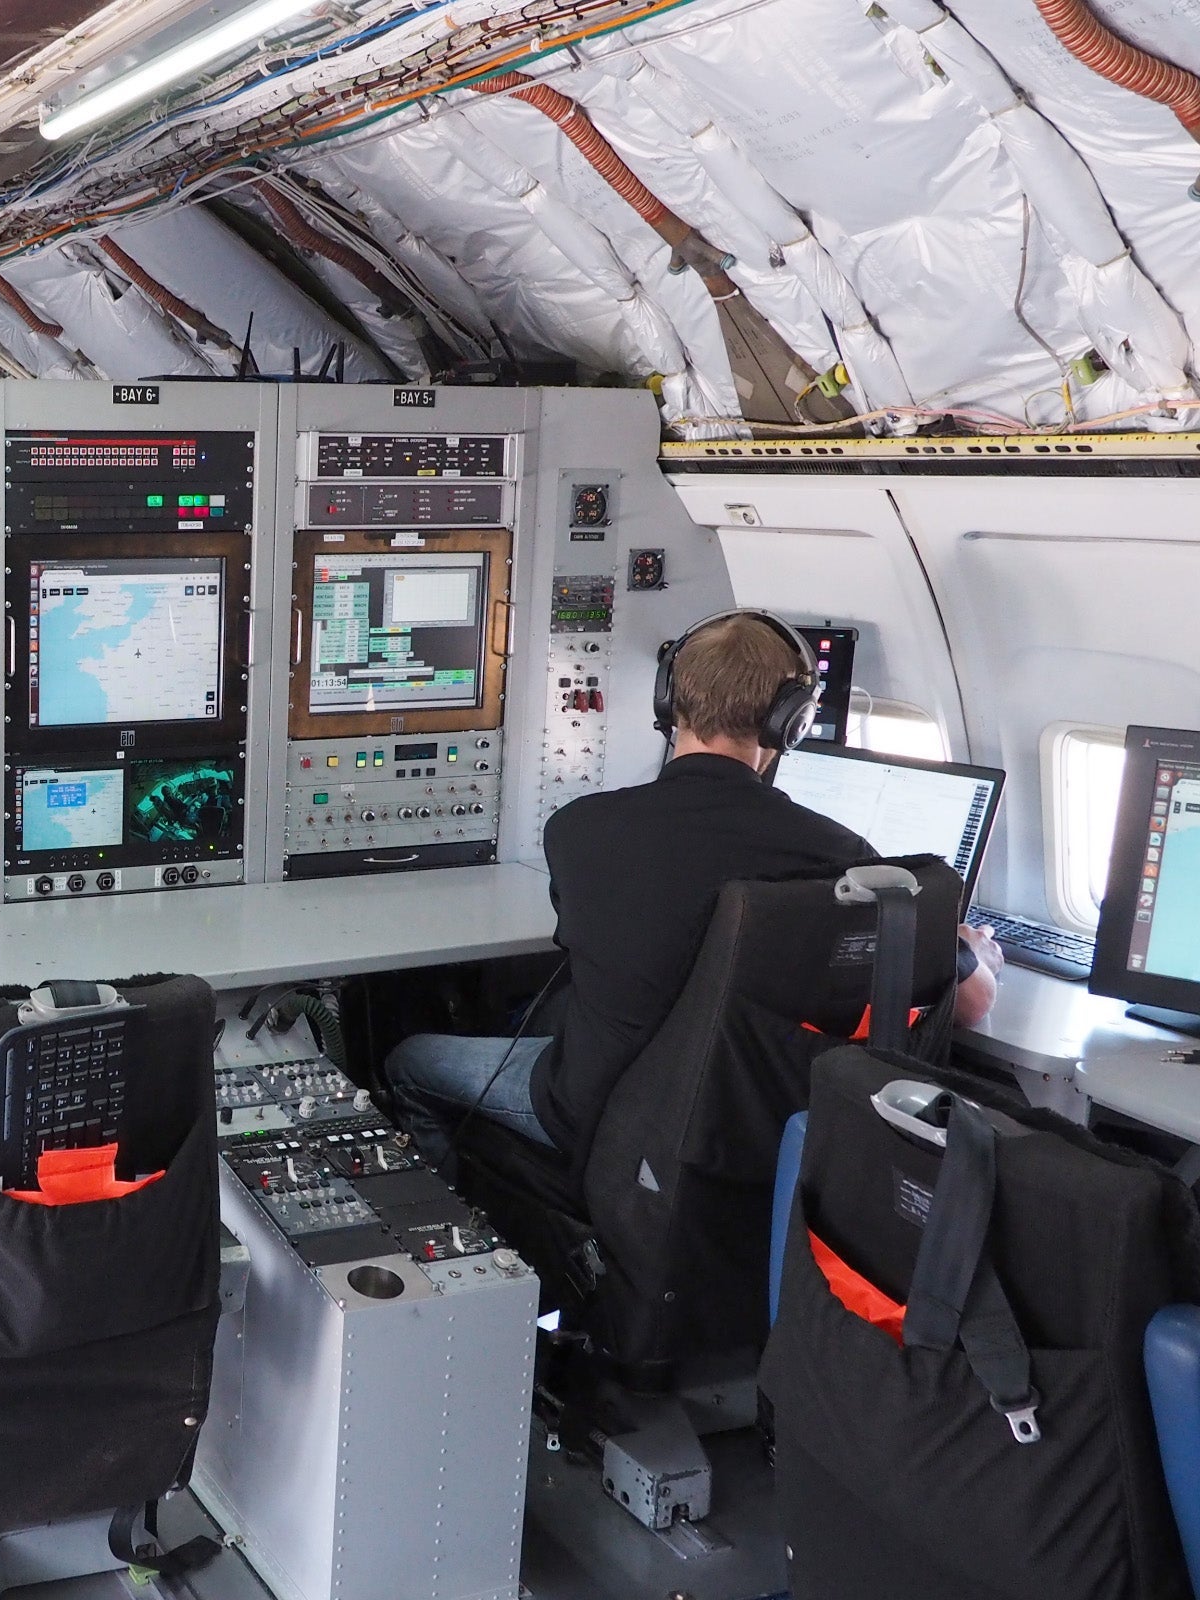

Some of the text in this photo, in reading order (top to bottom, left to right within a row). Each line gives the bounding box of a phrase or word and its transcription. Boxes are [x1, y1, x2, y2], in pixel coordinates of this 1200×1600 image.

[121, 388, 153, 402] BAY 6
[400, 391, 429, 405] BAY 5
[311, 678, 347, 688] 01:13:54
